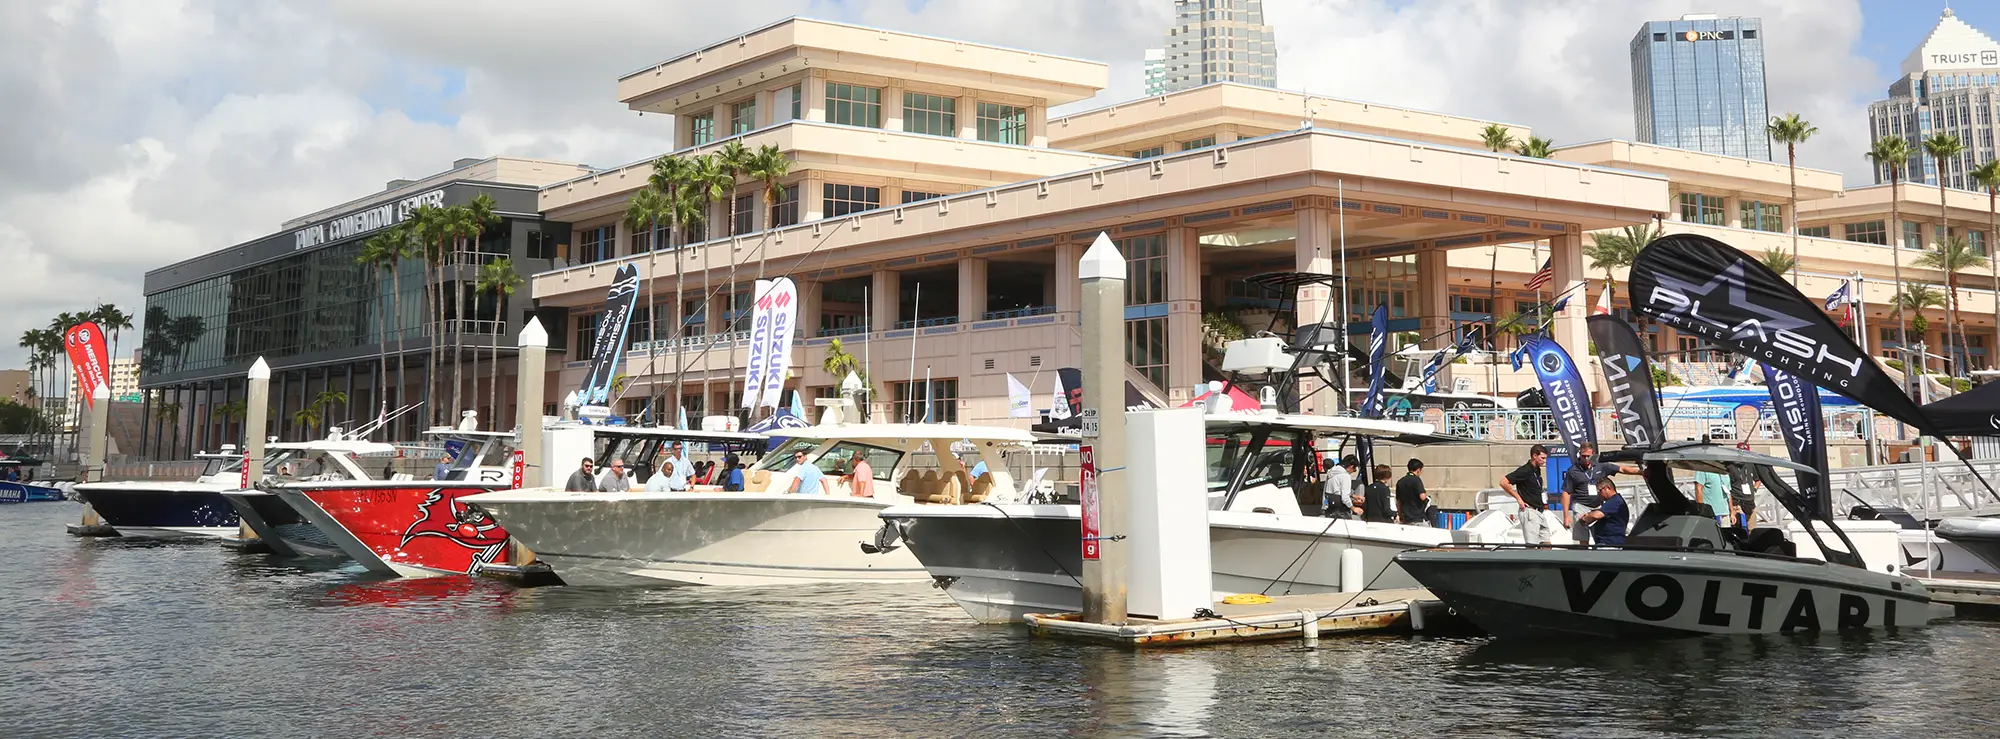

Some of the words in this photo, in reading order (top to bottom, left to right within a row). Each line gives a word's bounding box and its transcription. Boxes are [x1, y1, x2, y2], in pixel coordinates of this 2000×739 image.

[1700, 31, 1724, 40] PNC
[1931, 54, 1977, 63] TRUIST
[295, 224, 324, 250] TAMPA
[329, 204, 392, 241] CONVENTION
[398, 189, 444, 221] CENTER
[592, 309, 613, 359] ROSWE
[600, 304, 627, 371] ROSWELL
[748, 315, 767, 391] SUZUKI
[768, 312, 786, 389] SUZUKI
[1642, 307, 1722, 340] MARINE
[1739, 340, 1849, 388] LIGHTING
[1649, 286, 1862, 377] PLASH
[84, 343, 104, 383] MERCU
[1058, 426, 1082, 435] Klips
[1083, 422, 1090, 431] 14
[1092, 422, 1098, 431] 15
[514, 454, 523, 463] NO
[1081, 451, 1092, 464] NO
[0, 489, 21, 499] AMAHA
[1559, 567, 1903, 633] VOLTARI
